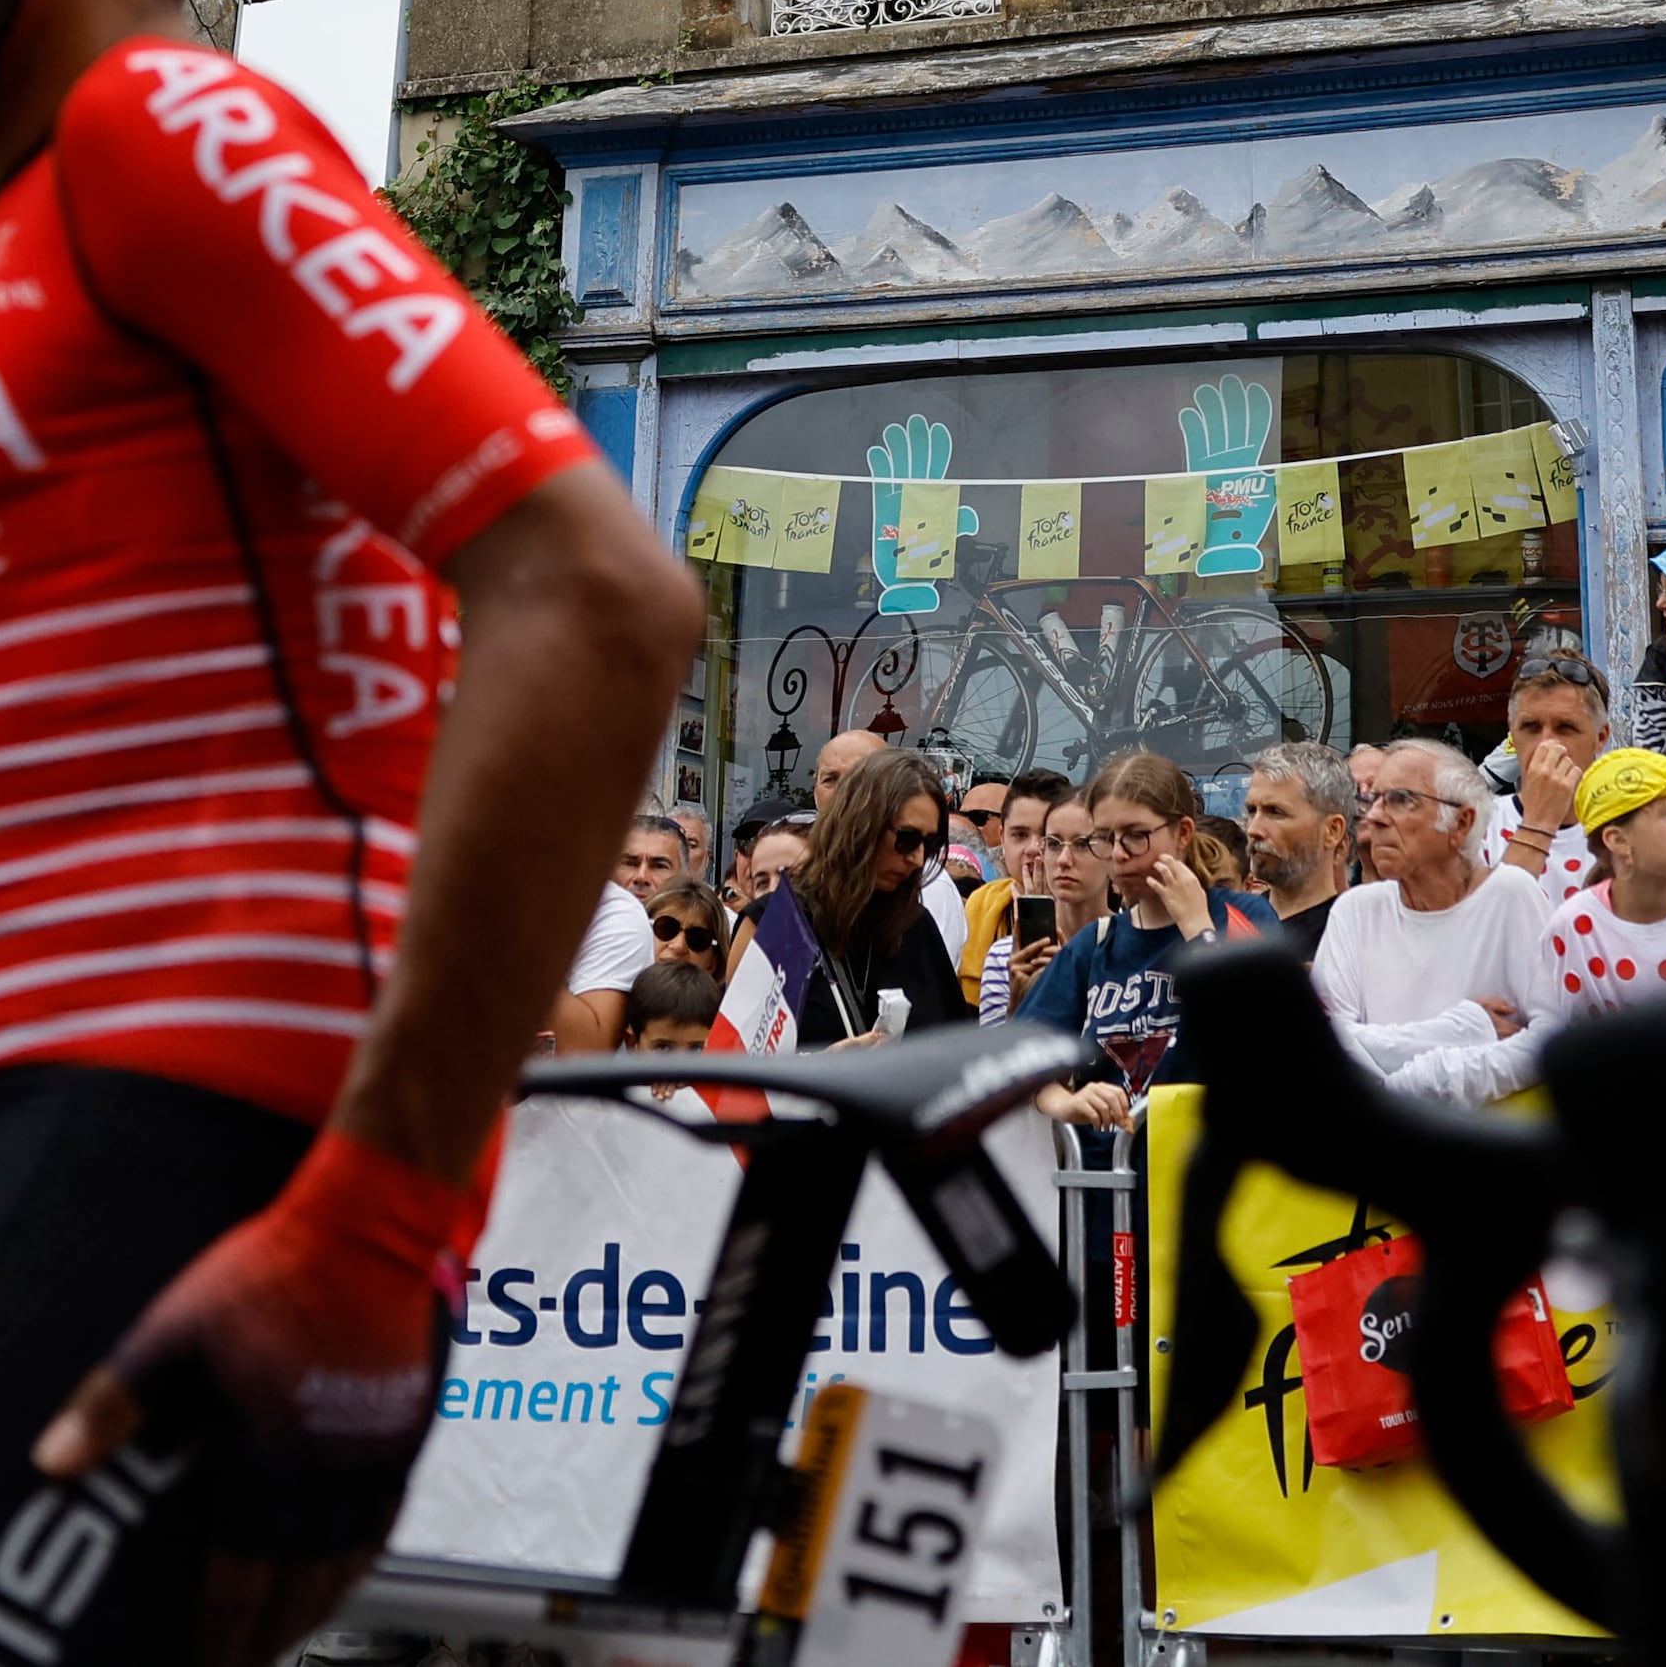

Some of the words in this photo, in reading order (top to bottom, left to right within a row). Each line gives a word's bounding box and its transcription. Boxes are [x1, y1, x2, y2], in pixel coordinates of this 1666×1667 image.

[125, 47, 469, 396] ARKEA
[1220, 477, 1267, 496] PMU
[1000, 607, 1095, 724] ORBEA
[1114, 1256, 1124, 1320] ALTRAD
[1379, 1413, 1406, 1430] TOUR
[842, 1439, 986, 1632] 151
